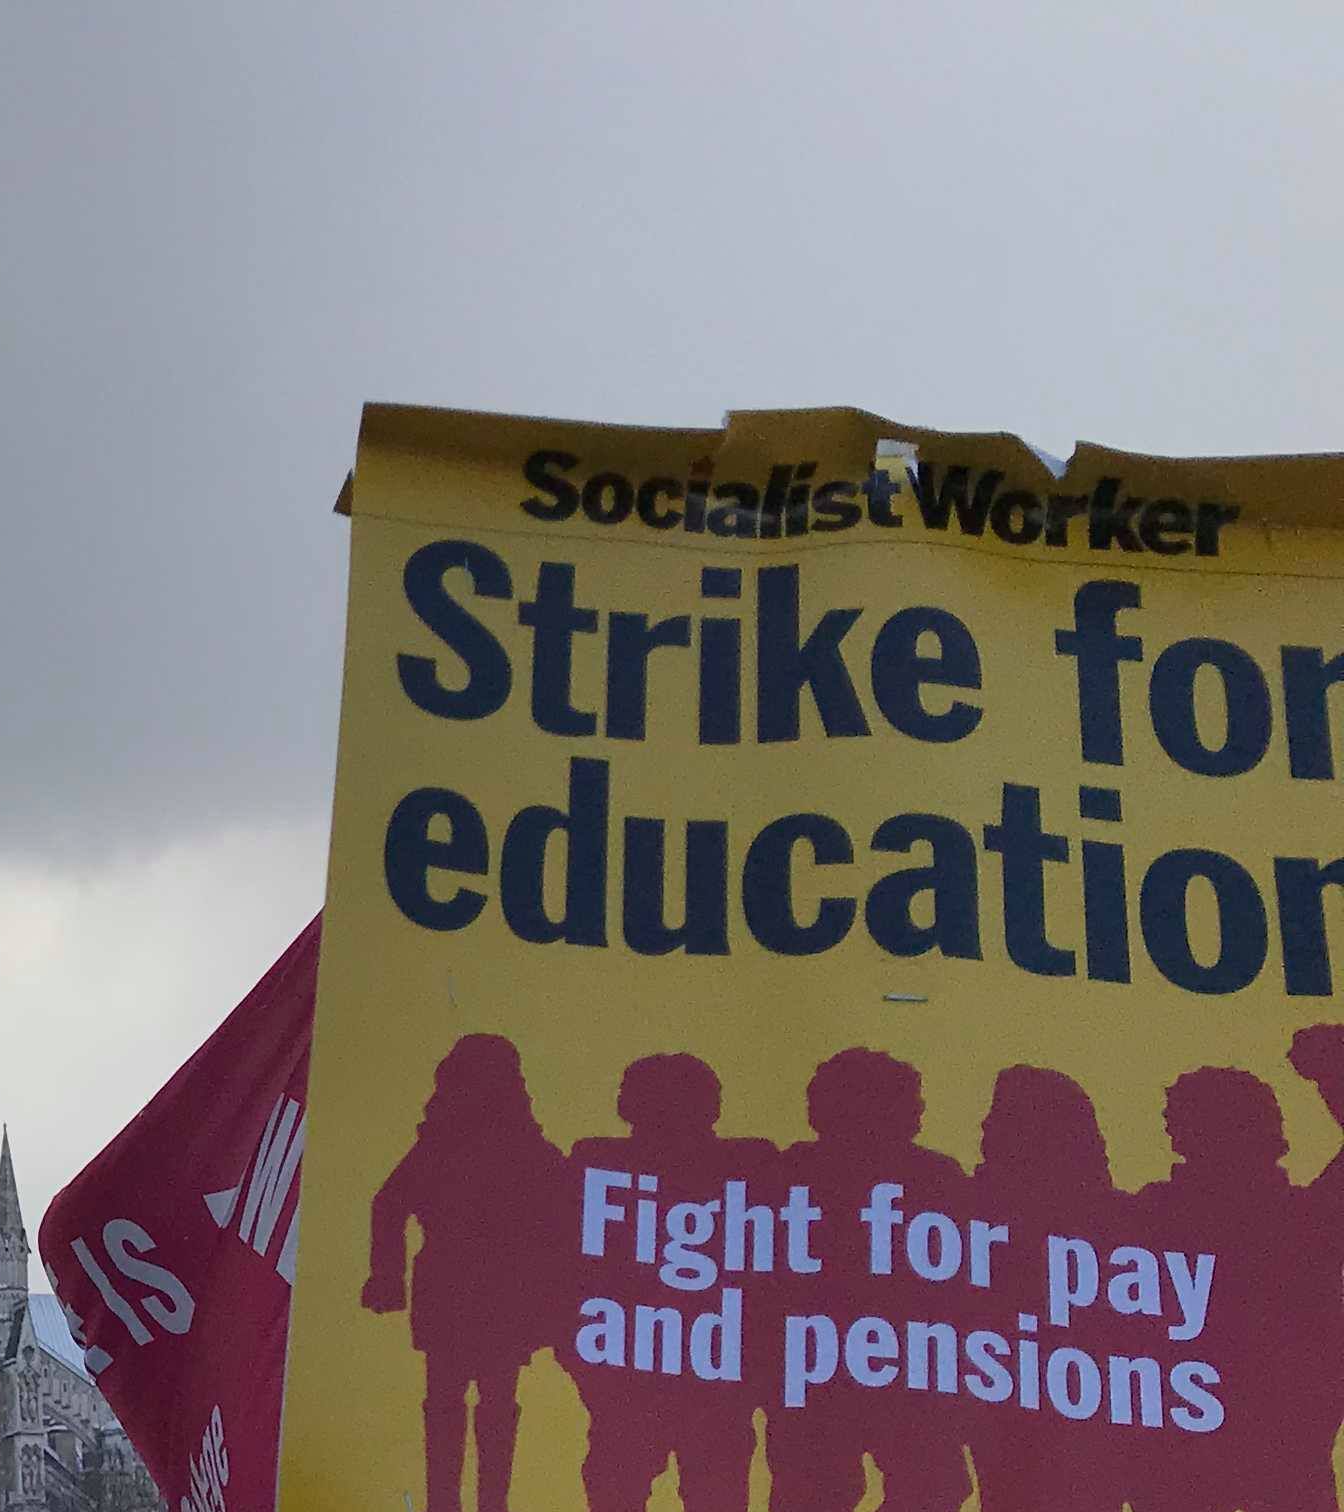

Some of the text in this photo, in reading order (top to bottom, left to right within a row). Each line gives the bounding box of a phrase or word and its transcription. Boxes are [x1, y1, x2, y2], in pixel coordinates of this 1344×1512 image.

[519, 450, 1241, 557] Socialist Worker
[396, 538, 1344, 783] Strike for
[382, 756, 1344, 997] education
[579, 1167, 1217, 1341] Fight for pay
[573, 1286, 1227, 1434] and pensions
